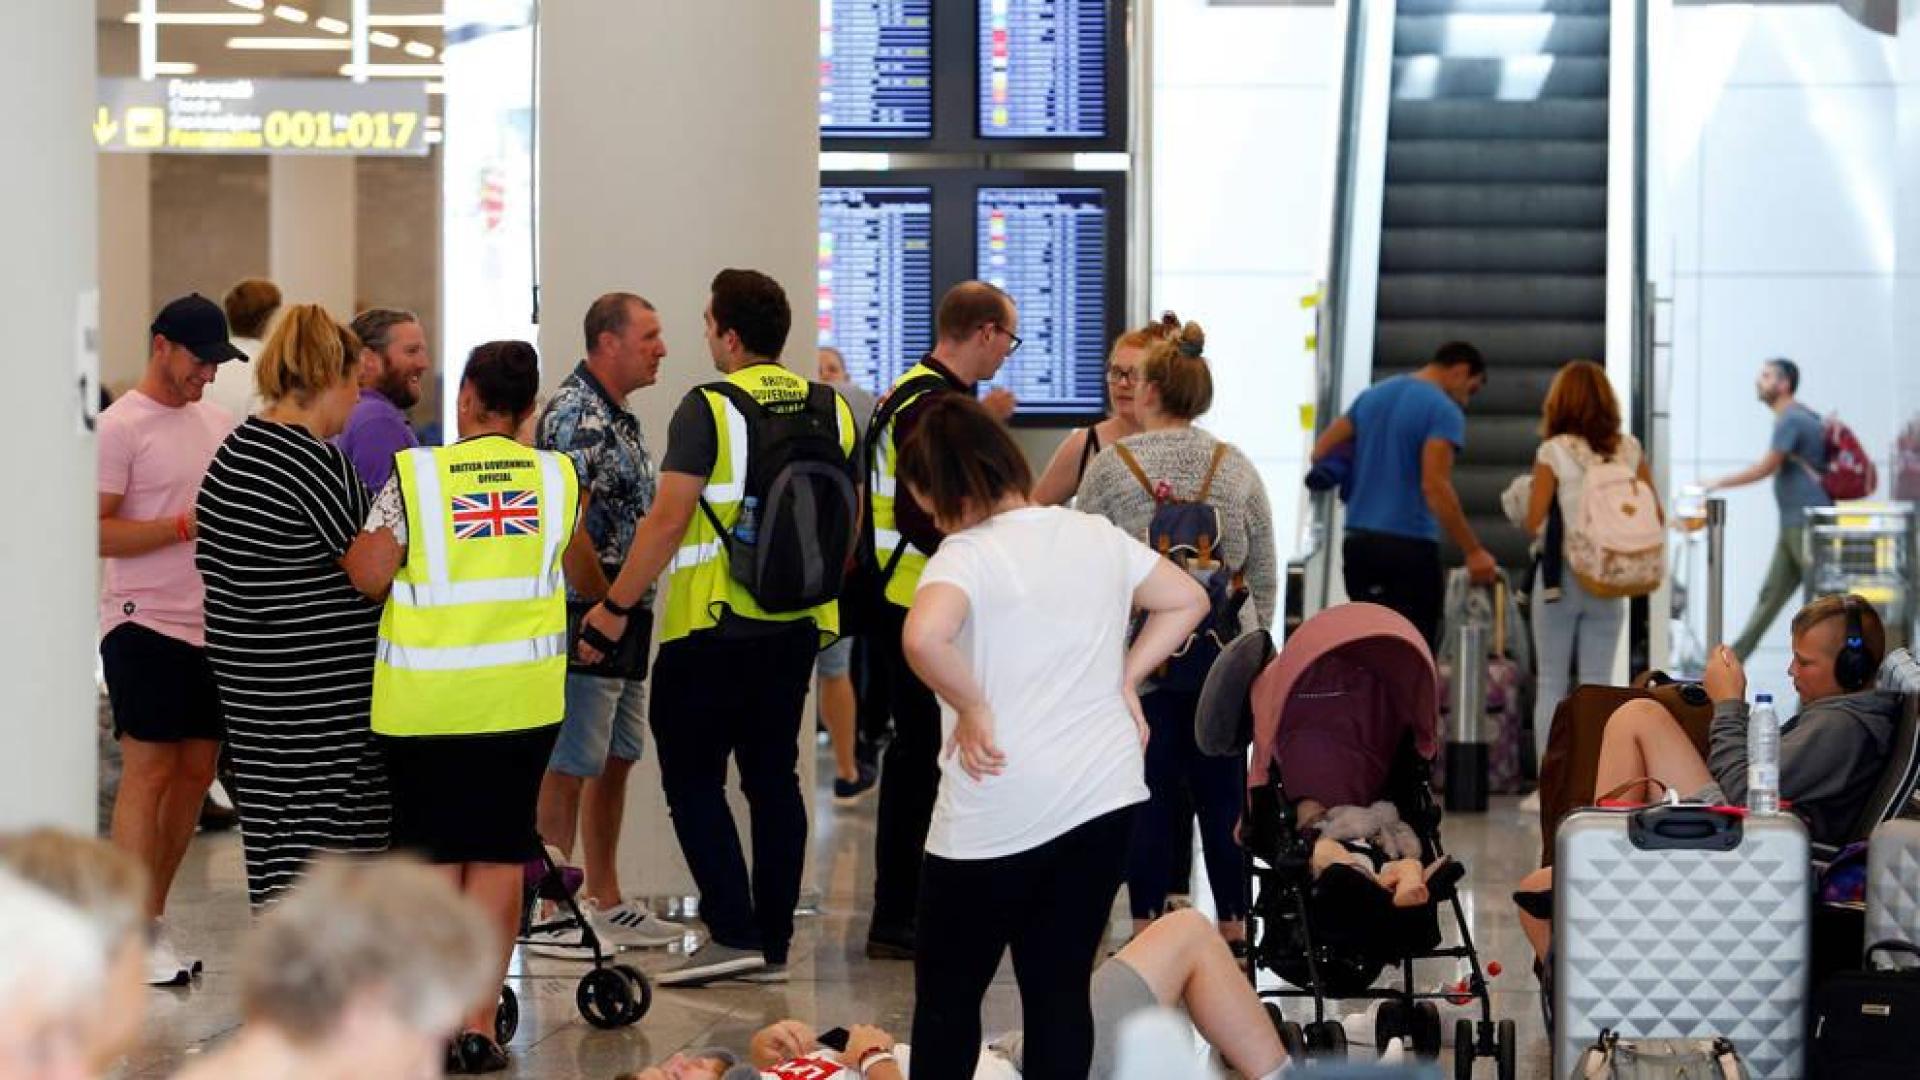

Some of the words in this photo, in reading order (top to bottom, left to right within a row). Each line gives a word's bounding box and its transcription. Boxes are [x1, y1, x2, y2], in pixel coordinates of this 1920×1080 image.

[449, 462, 483, 473] BRITISH
[484, 460, 535, 470] GOVERNMENT
[478, 472, 512, 483] OFFICIAL
